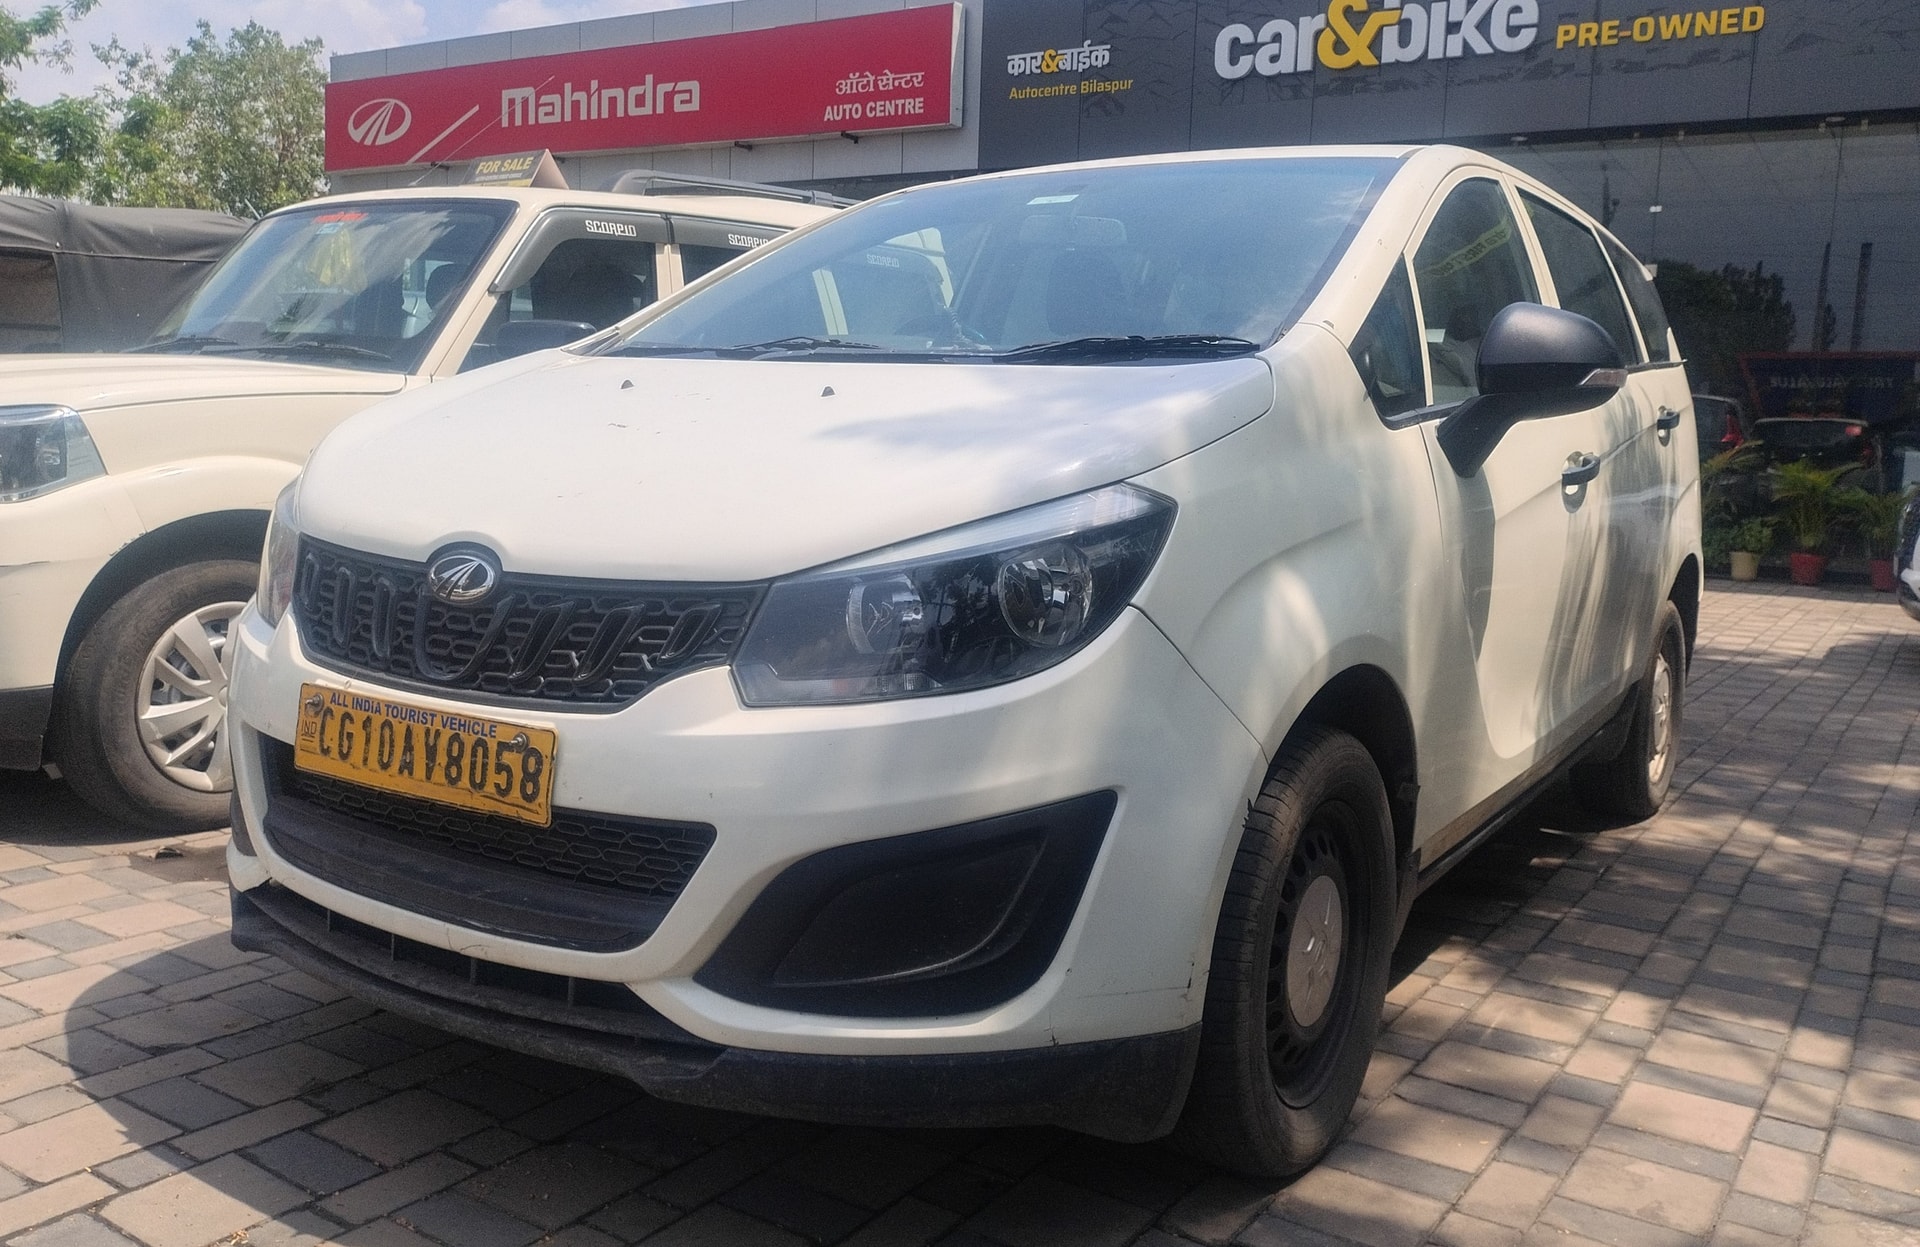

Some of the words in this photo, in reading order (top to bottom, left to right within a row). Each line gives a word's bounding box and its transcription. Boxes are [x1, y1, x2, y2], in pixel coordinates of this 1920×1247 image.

[1556, 5, 1766, 49] PRE-OWNED
[835, 71, 875, 95] ऑटो
[877, 69, 925, 91] सेन्टर
[1009, 84, 1077, 99] Autocentre
[1080, 79, 1134, 94] Bilaspur
[501, 74, 700, 128] Mahindra
[824, 103, 862, 121] AUTO
[866, 97, 924, 117] CENTRE
[475, 160, 501, 175] FOR
[501, 156, 535, 172] SALE
[585, 219, 637, 237] SCORPIO
[330, 692, 349, 708] ALL
[352, 696, 382, 716] INDIA
[384, 703, 437, 727] TOURIST
[441, 715, 497, 738] VEHICLE
[318, 706, 544, 803] CG10AV8058
